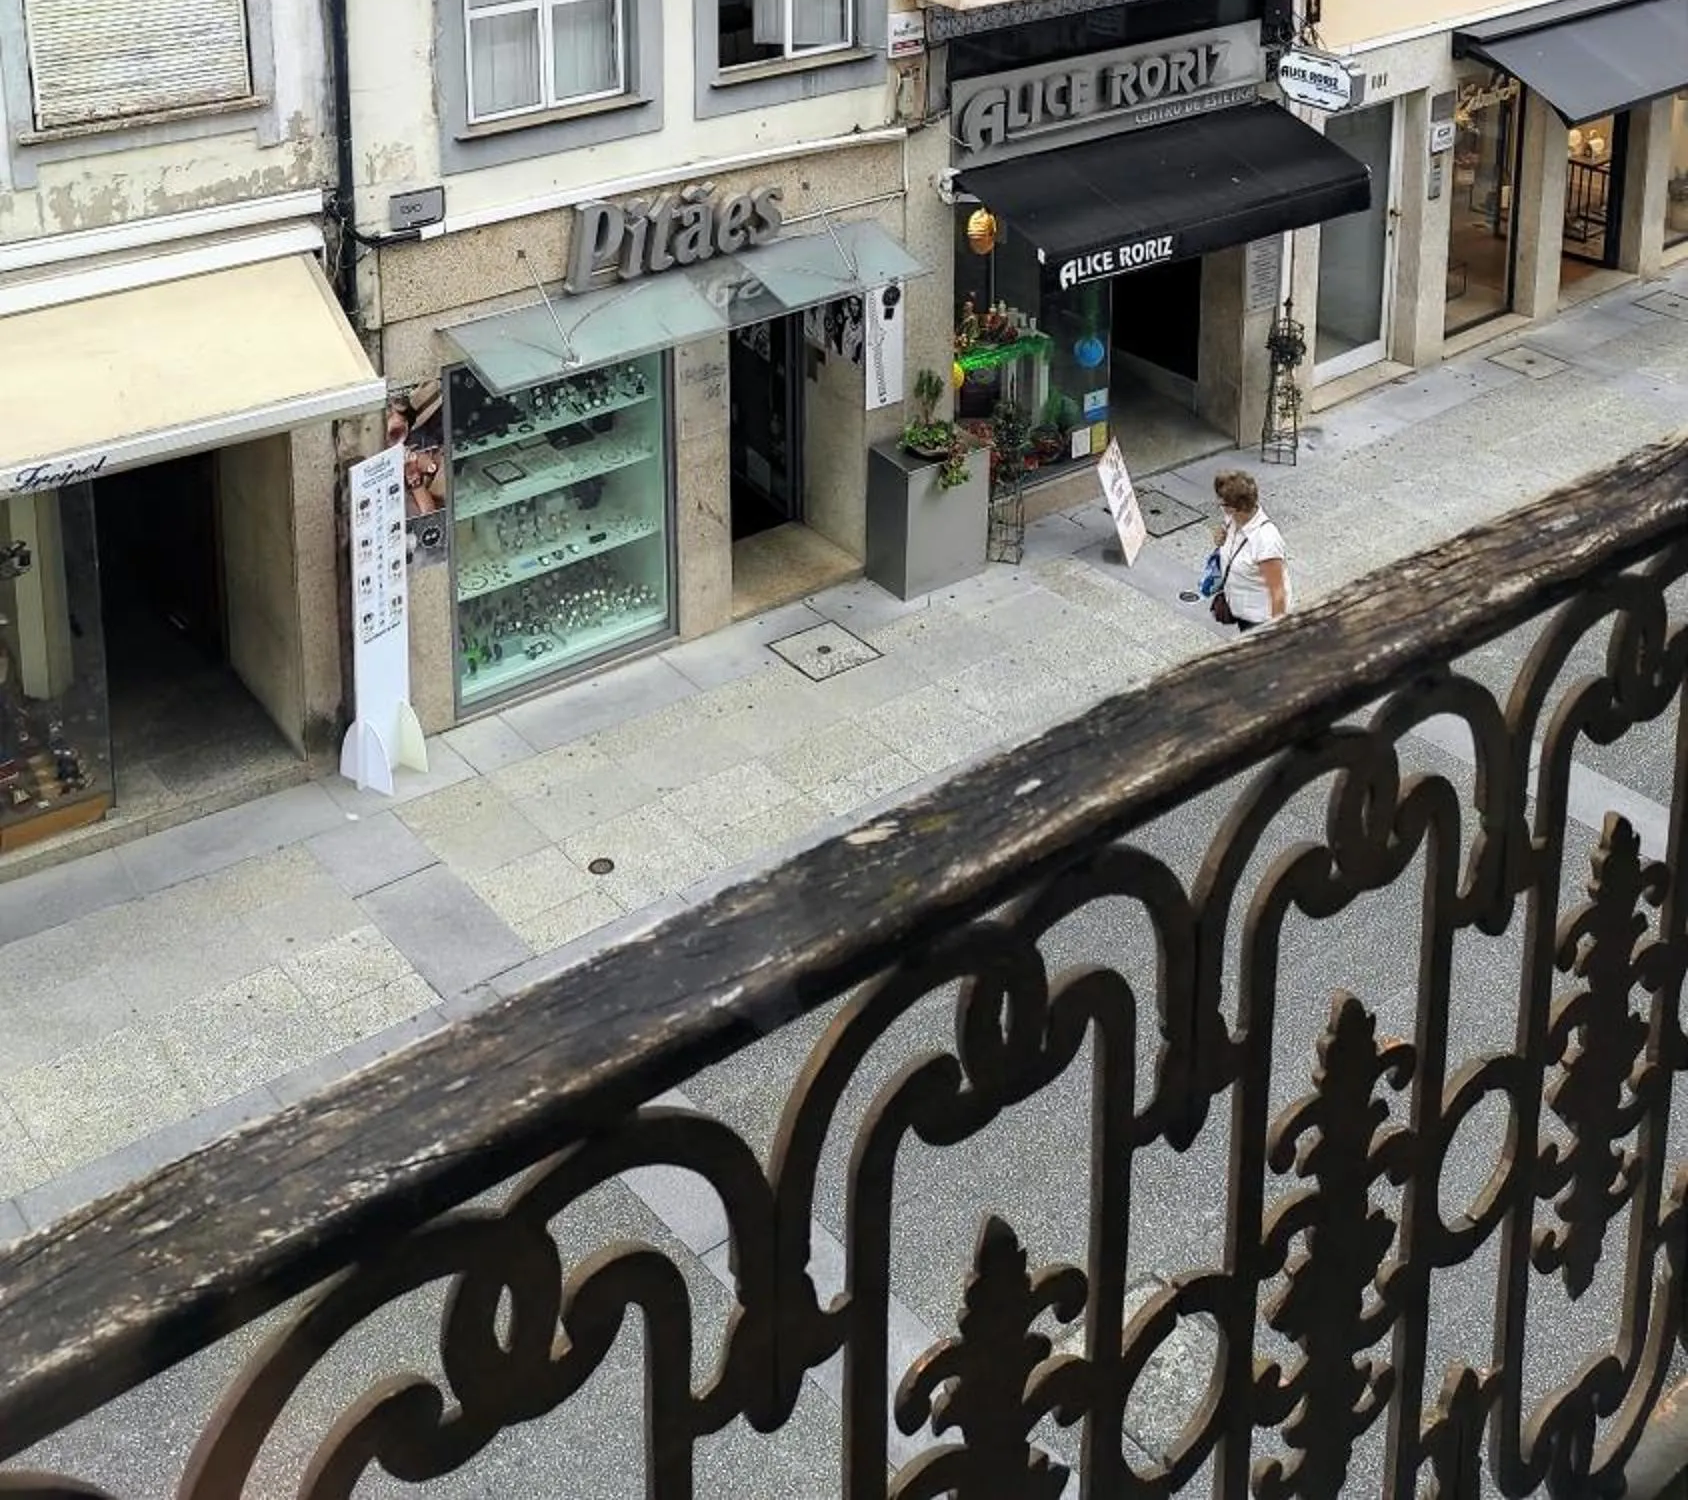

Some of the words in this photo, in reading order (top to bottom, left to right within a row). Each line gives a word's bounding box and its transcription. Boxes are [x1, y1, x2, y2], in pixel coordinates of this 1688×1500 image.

[962, 70, 1097, 152] ALICE
[1106, 40, 1231, 106] RORIZ
[1281, 65, 1307, 79] ALICE
[1309, 71, 1339, 88] RORIZ
[563, 181, 784, 295] Pitães
[1060, 251, 1115, 291] ALICE
[1119, 235, 1173, 267] RORIZ
